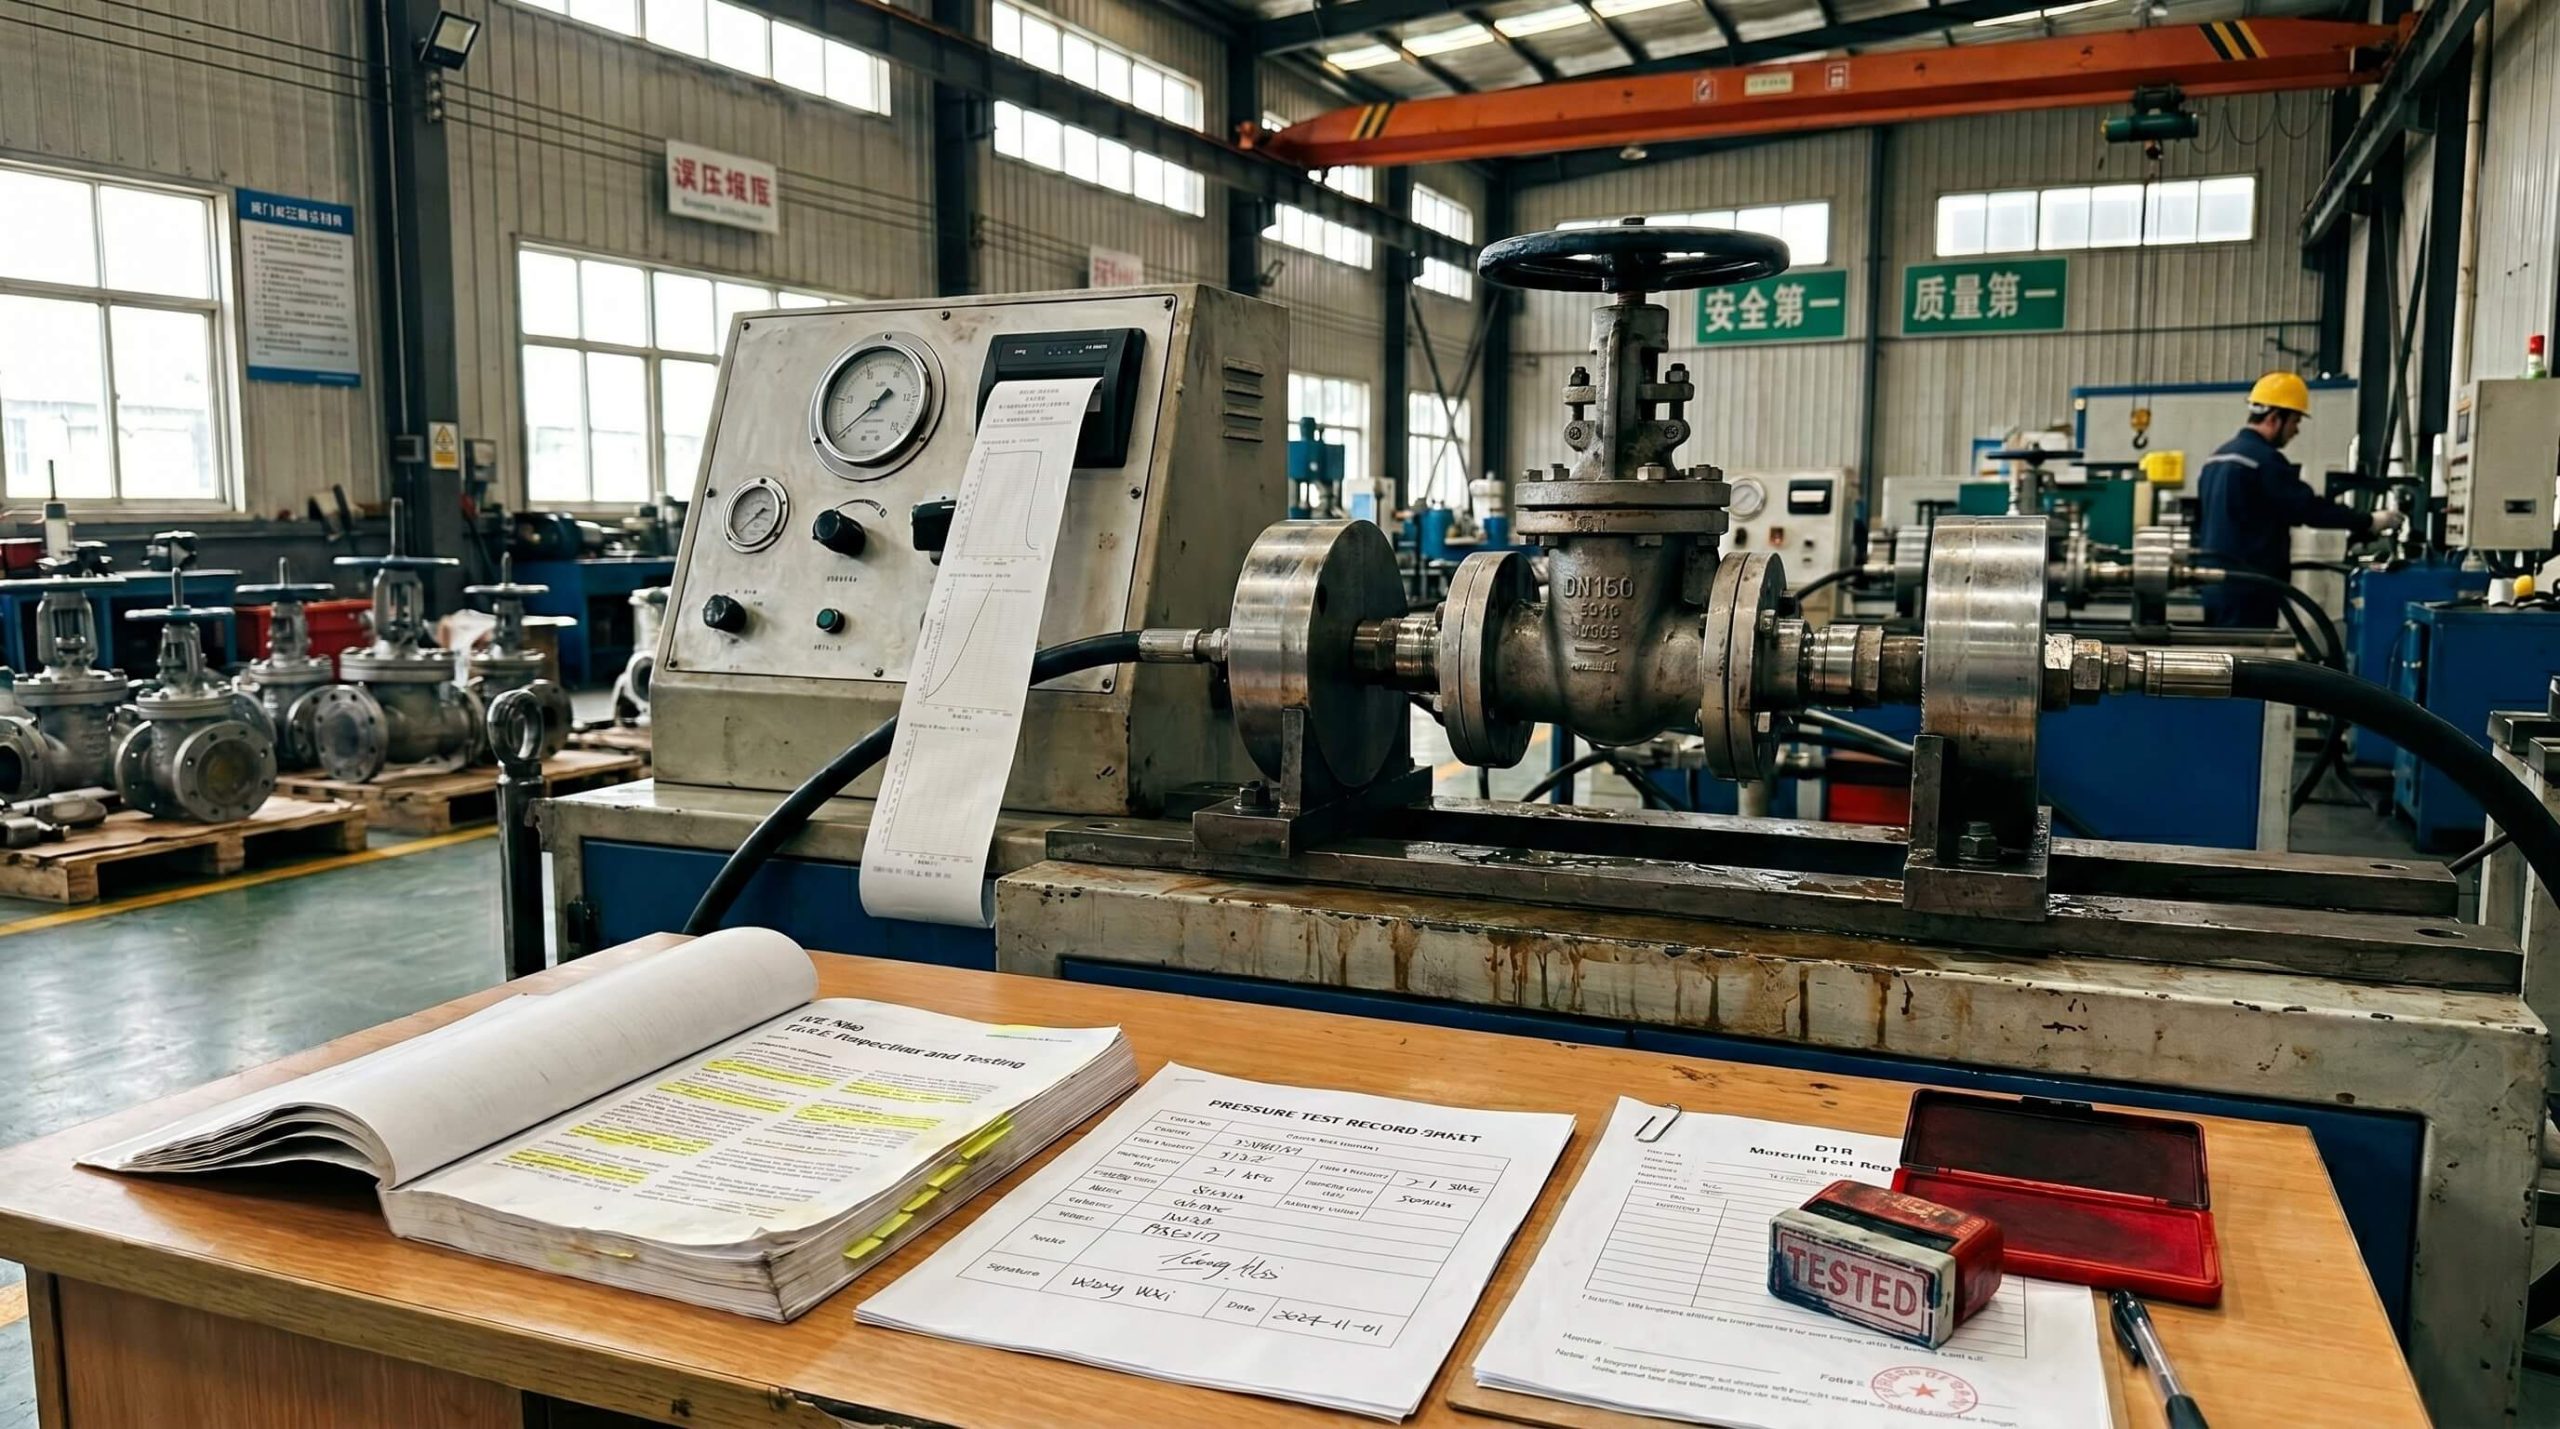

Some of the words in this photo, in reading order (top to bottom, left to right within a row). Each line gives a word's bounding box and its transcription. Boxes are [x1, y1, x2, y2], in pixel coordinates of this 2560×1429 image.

[1704, 283, 1840, 333] 安全第一
[1912, 272, 2057, 322] 质量第一
[923, 1049, 961, 1062] and
[1208, 1099, 1299, 1119] PRESSURE
[1301, 1111, 1343, 1125] TEST
[1346, 1118, 1418, 1136] RECORD
[986, 1262, 1040, 1277] Signature
[1786, 1244, 1918, 1318] TESTED
